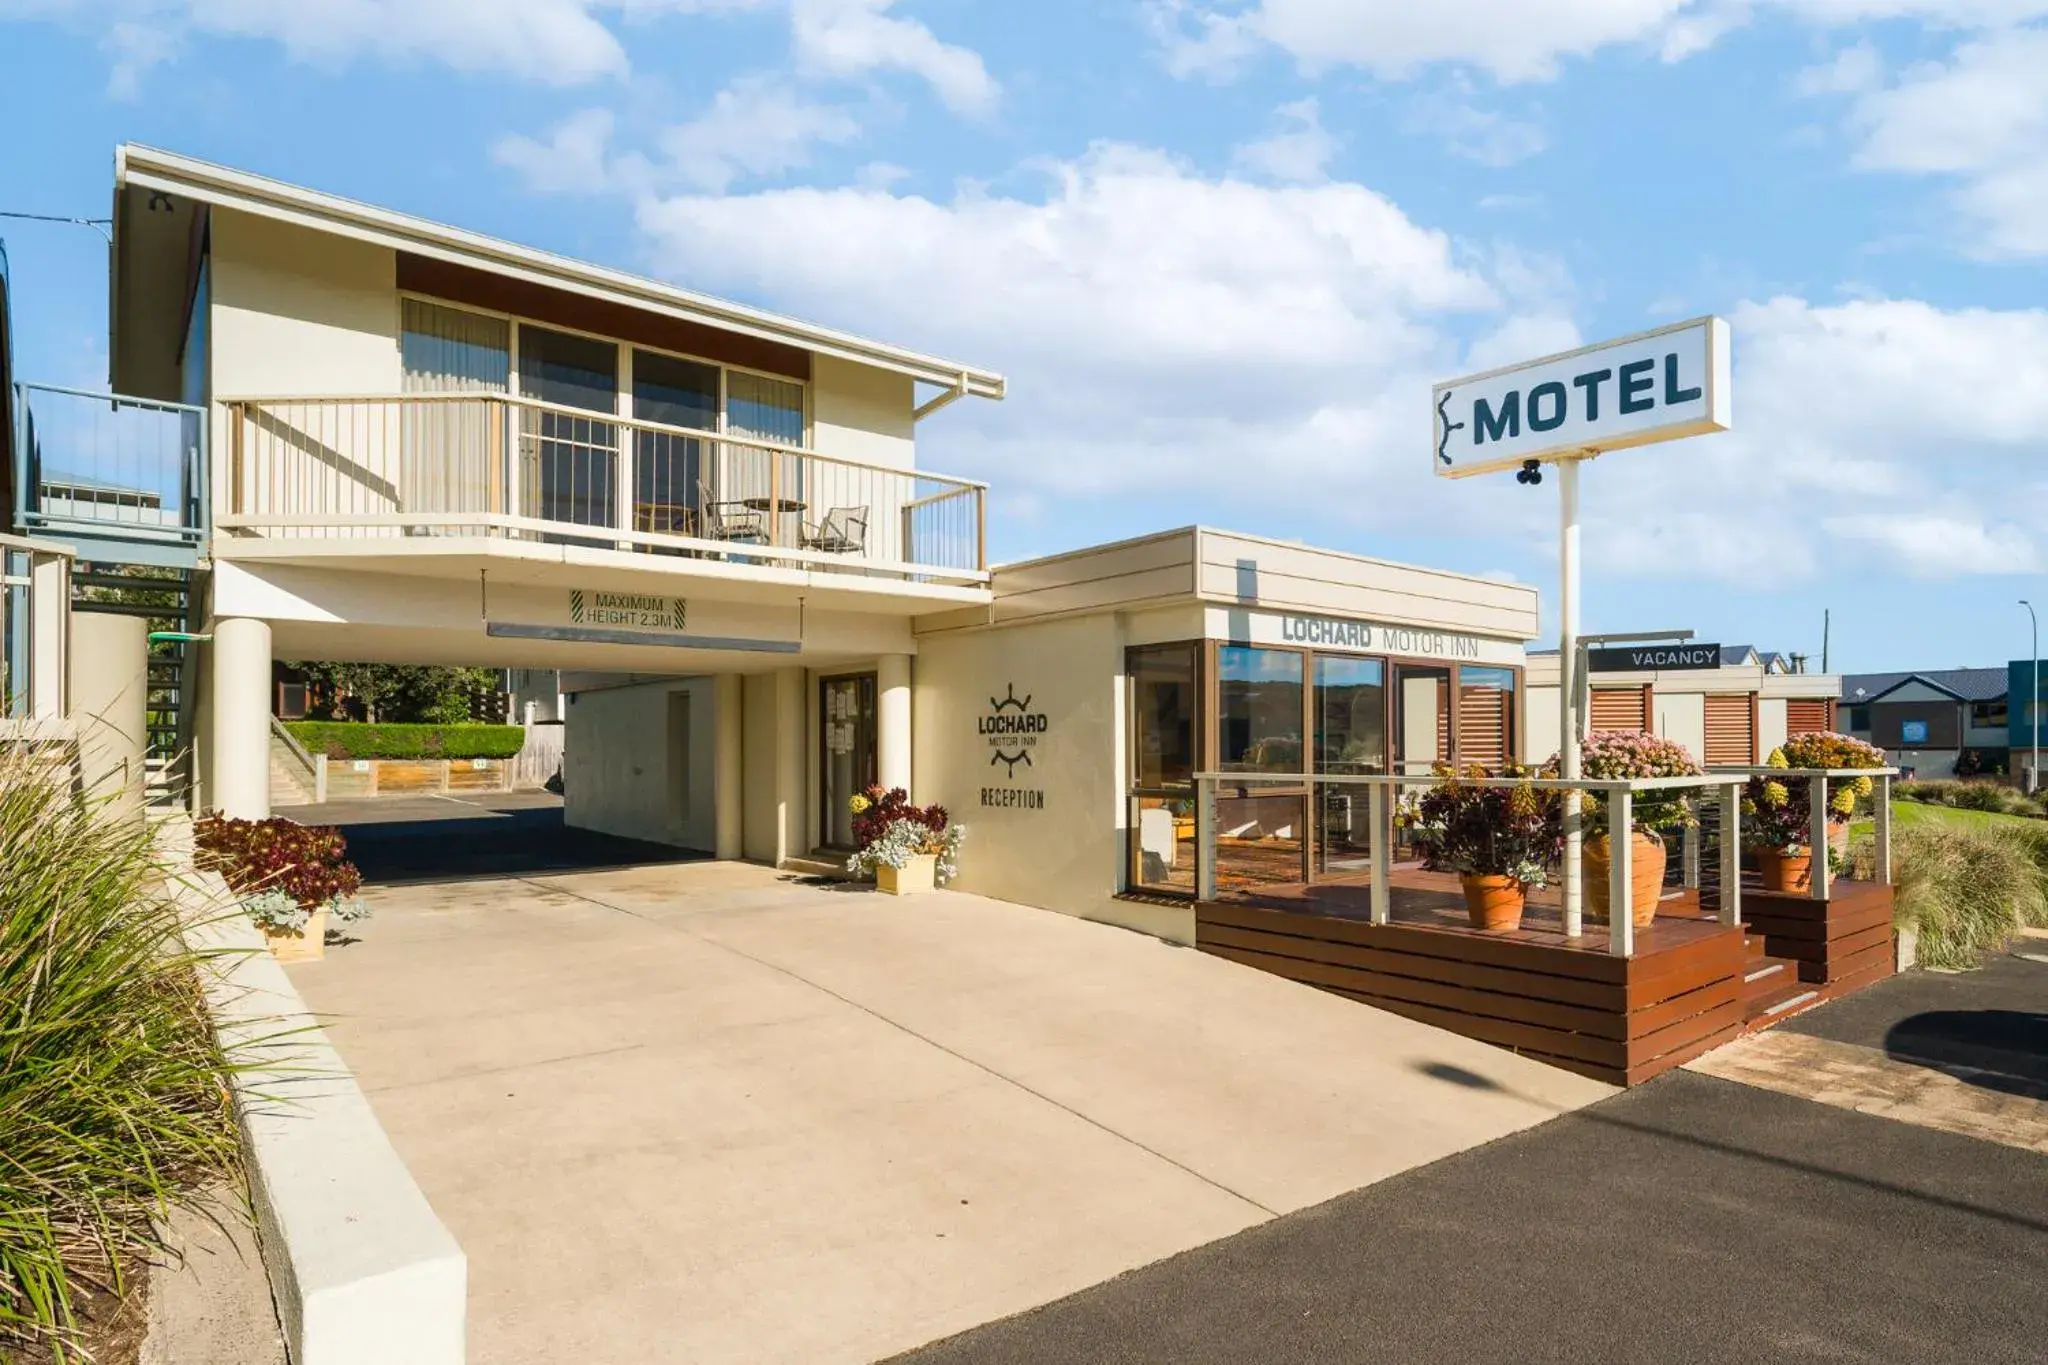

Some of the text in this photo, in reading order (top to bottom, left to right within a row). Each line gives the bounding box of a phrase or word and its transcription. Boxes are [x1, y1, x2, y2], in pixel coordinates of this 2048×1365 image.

[1474, 353, 1702, 445] MOTEL
[595, 593, 664, 612] MAXIMUM
[587, 609, 672, 628] HEIGHT 2.3M
[1282, 616, 1479, 658] LOCHARD MOTOR INN
[1632, 650, 1716, 666] VACANCY
[978, 714, 1048, 735] LOCHARD
[988, 736, 1037, 747] MOTOR INN
[981, 787, 1044, 809] RECEPTION
